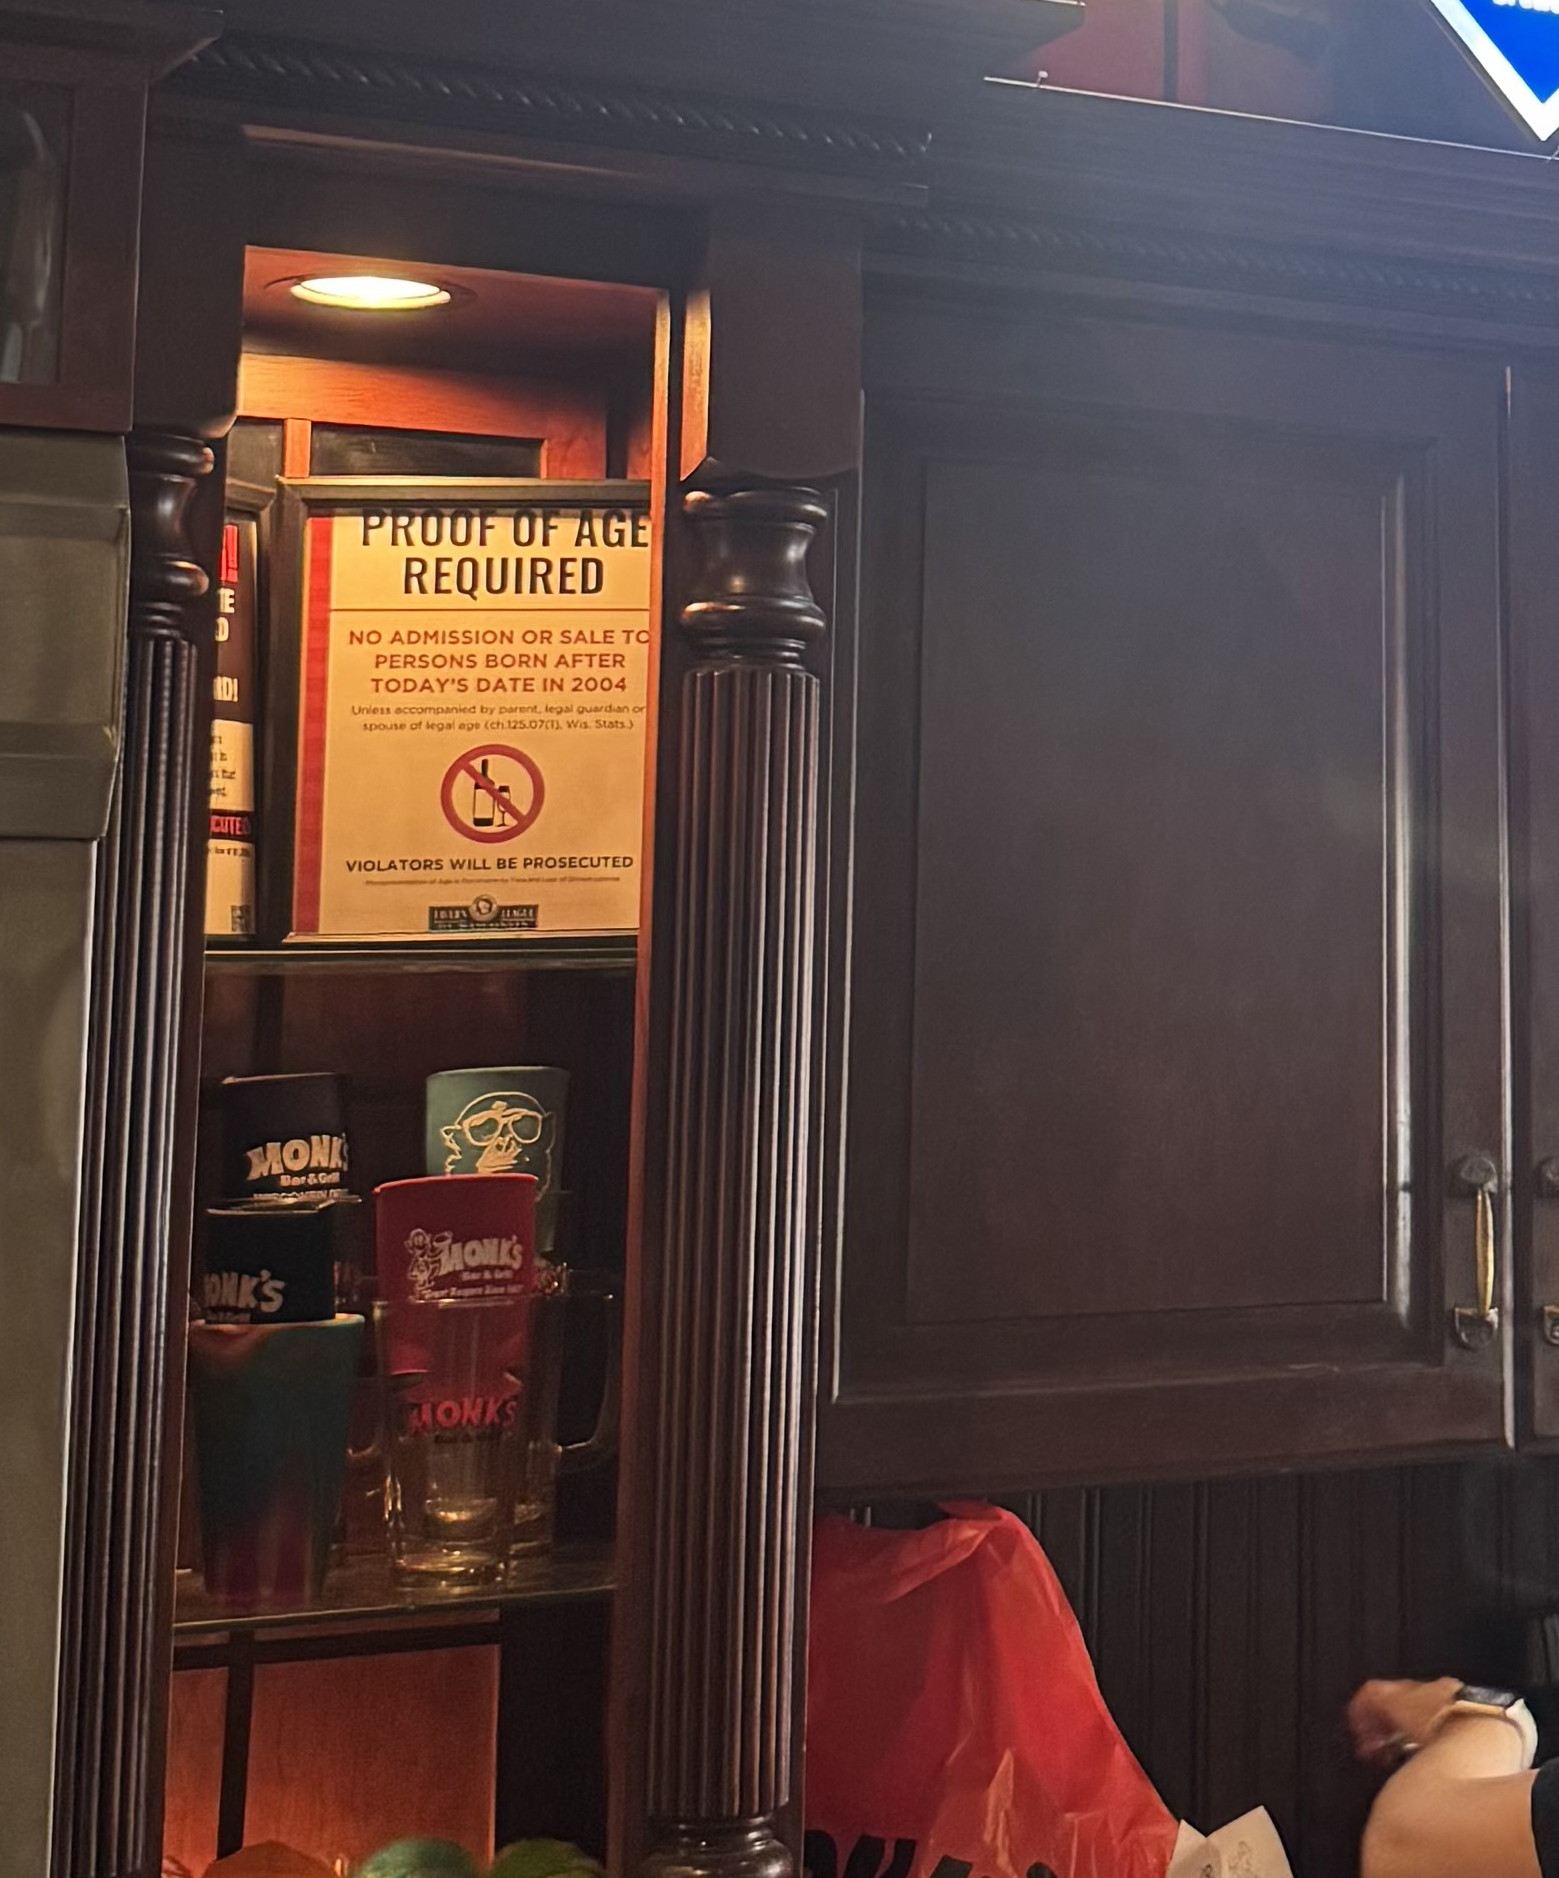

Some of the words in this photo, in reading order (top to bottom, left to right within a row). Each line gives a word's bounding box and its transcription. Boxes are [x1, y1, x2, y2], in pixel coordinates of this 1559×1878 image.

[361, 508, 497, 547] PROOF
[513, 509, 560, 547] OF
[574, 510, 649, 548] AGE
[403, 556, 604, 601] REQUIRED
[348, 629, 382, 645] NO
[390, 629, 514, 645] ADMISSION
[521, 629, 552, 644] OR
[560, 629, 615, 645] SALE
[375, 653, 478, 670] PERSONS
[486, 653, 548, 669] BORN
[555, 653, 626, 669] AFTER
[371, 677, 469, 694] TODAY'S
[477, 677, 535, 693] DATE
[543, 677, 565, 693] IN
[572, 677, 627, 693] 2004
[352, 705, 391, 715] Unless
[394, 705, 476, 716] accompanied
[480, 705, 496, 716] by
[545, 703, 574, 715] legal
[576, 703, 630, 715] guardian
[632, 704, 646, 713] or
[363, 721, 406, 732] spouse
[409, 720, 423, 730] of
[426, 720, 455, 732] legal
[458, 720, 481, 731] age
[346, 858, 444, 873] VIOLATORS
[450, 857, 492, 871] WILL
[496, 857, 518, 870] BE
[523, 856, 634, 870] PROSECUTED
[203, 1268, 287, 1314] ONK'S
